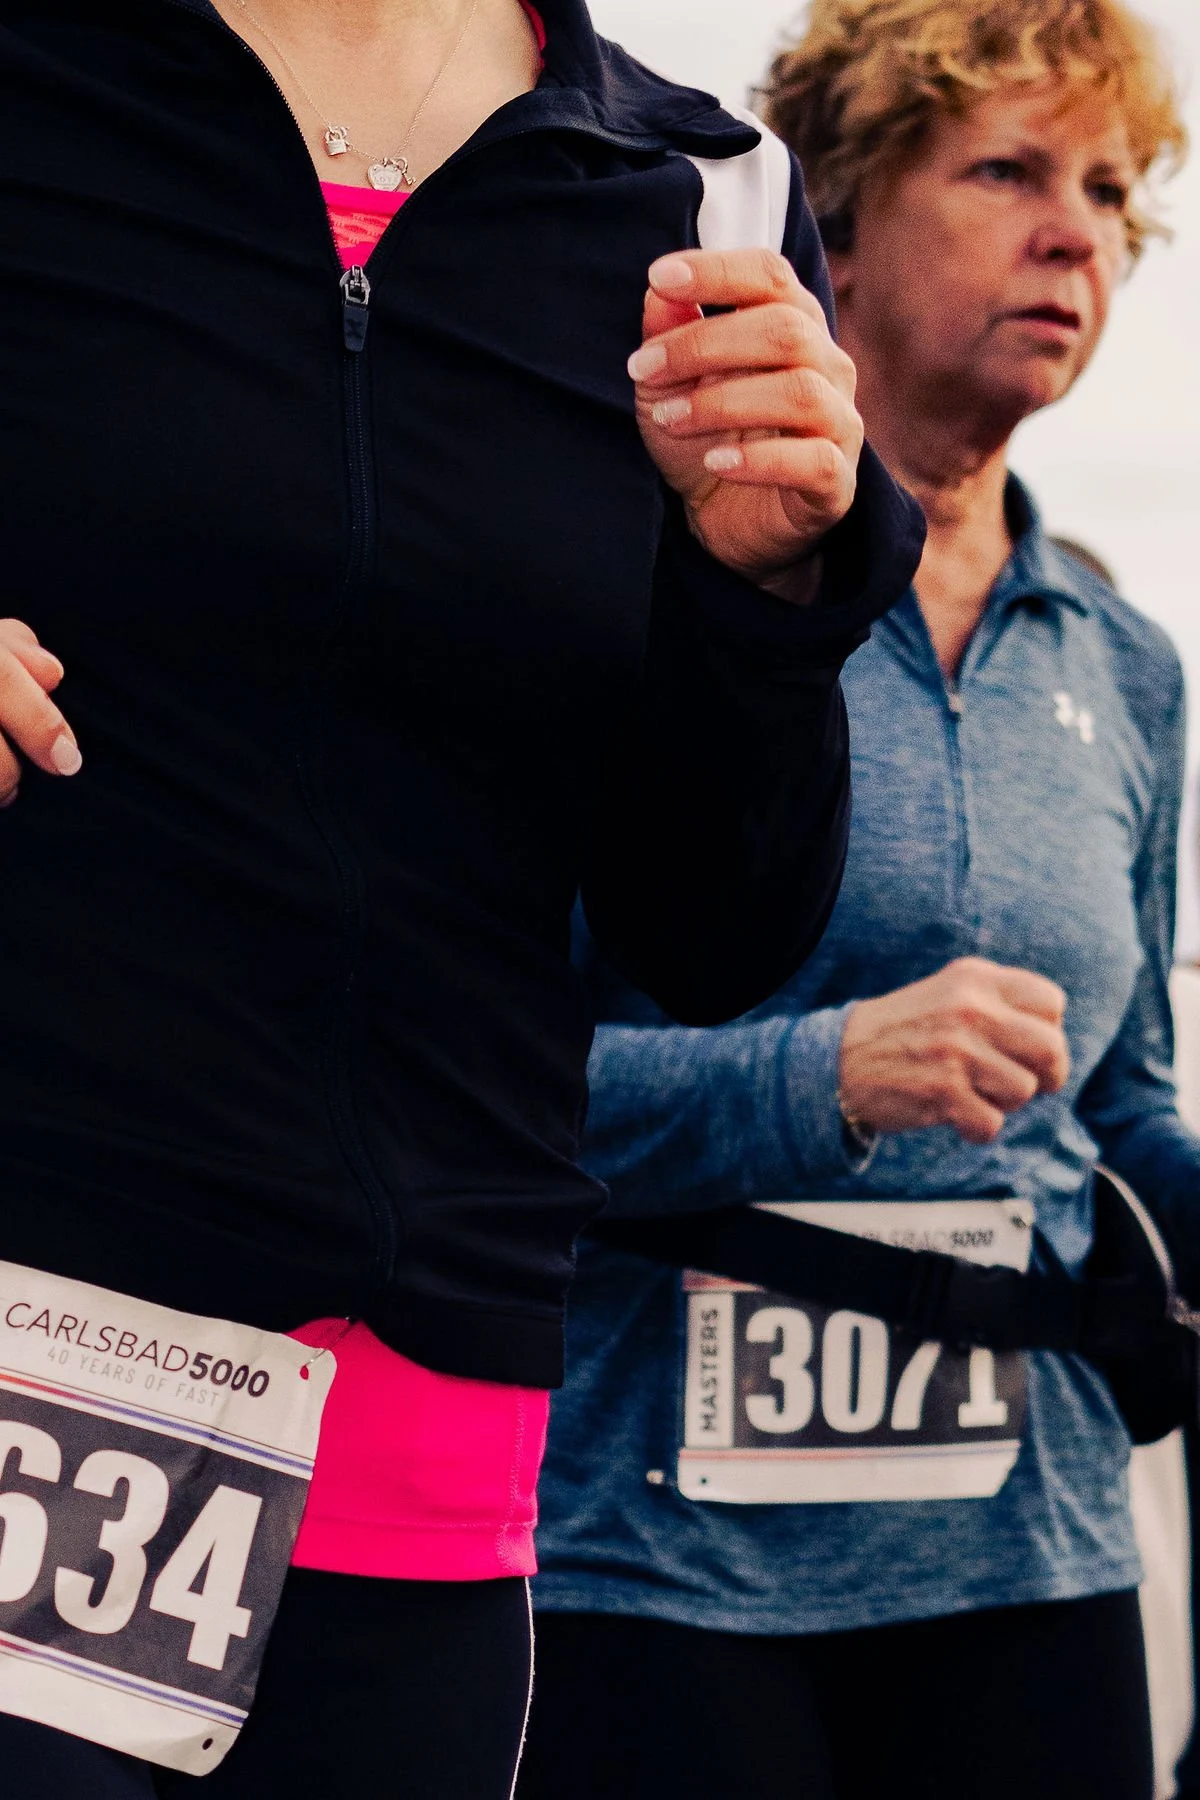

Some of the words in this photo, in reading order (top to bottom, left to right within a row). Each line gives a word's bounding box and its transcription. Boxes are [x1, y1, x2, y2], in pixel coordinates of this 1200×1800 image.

[5, 1302, 270, 1398] CARLSBAD5000
[47, 1346, 68, 1366] 40
[80, 1355, 136, 1385] YEARS
[144, 1374, 165, 1392] OF
[175, 1382, 219, 1408] FAST
[700, 1308, 719, 1432] MASTERS
